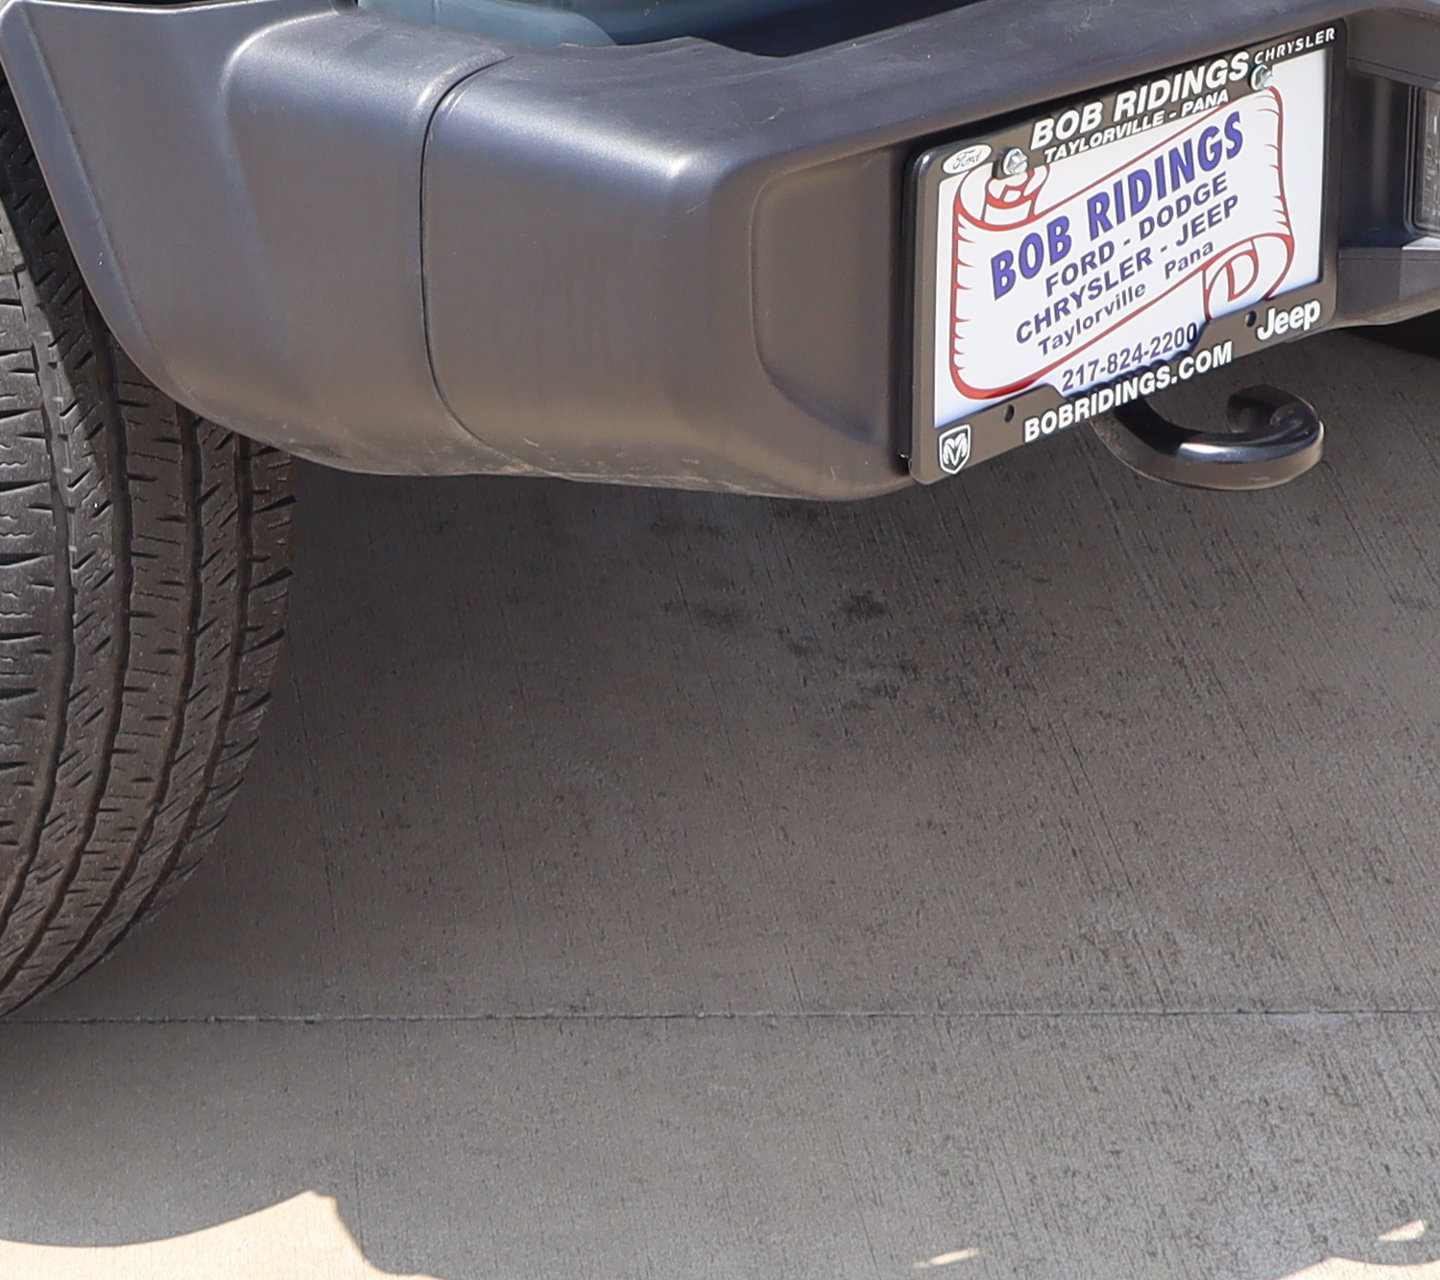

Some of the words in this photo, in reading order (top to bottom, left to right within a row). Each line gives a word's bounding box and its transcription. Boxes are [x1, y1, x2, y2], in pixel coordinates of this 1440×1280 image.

[1254, 27, 1336, 65] CHRYSLER
[1030, 102, 1104, 149] BOB
[1113, 51, 1250, 122] RIDINGS
[1043, 114, 1165, 164] TAYLORVILLE
[1182, 90, 1230, 116] PANA
[989, 215, 1072, 301] BOB
[1086, 110, 1244, 240] RIDINGS
[1045, 243, 1115, 297] FORD
[1139, 171, 1229, 237] DODGE
[1016, 250, 1153, 345] CHRYSLER
[1175, 195, 1240, 255] JEEP
[1037, 281, 1146, 357] Taylorville
[1164, 241, 1215, 281] Pana
[1061, 321, 1198, 393] 217-824-2200
[1256, 300, 1321, 341] Jeep
[1024, 341, 1234, 442] BOBRIDINGS.COM
